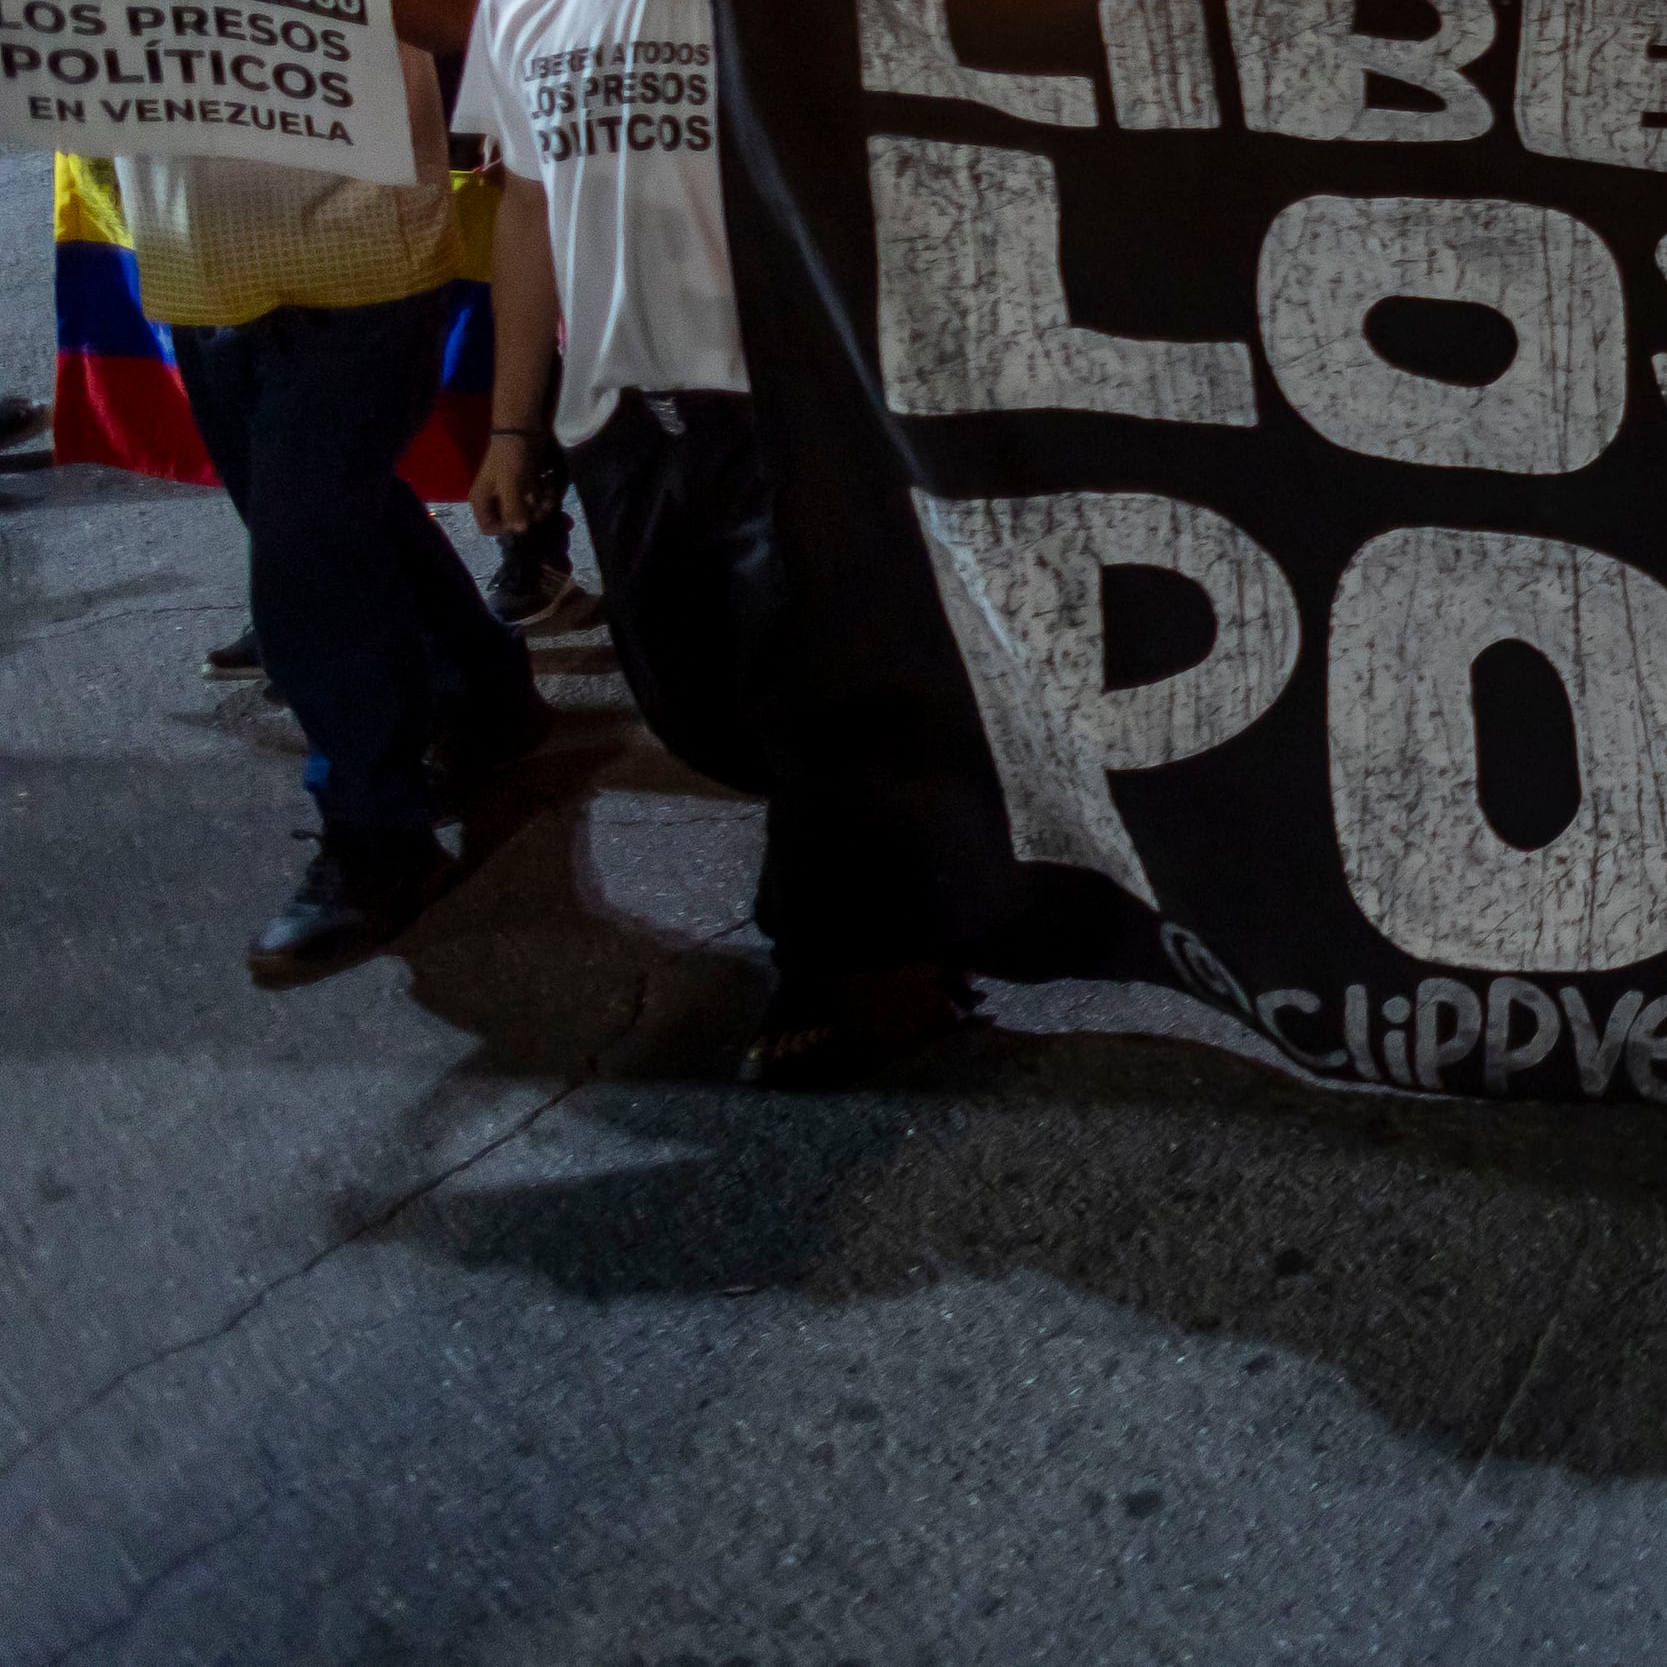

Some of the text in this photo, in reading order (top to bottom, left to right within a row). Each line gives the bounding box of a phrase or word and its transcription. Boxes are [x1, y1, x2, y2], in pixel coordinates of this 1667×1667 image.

[126, 5, 352, 63] PRESOS
[1, 39, 355, 109] POLÍTICOS
[28, 95, 355, 147] EN VENEZUELA
